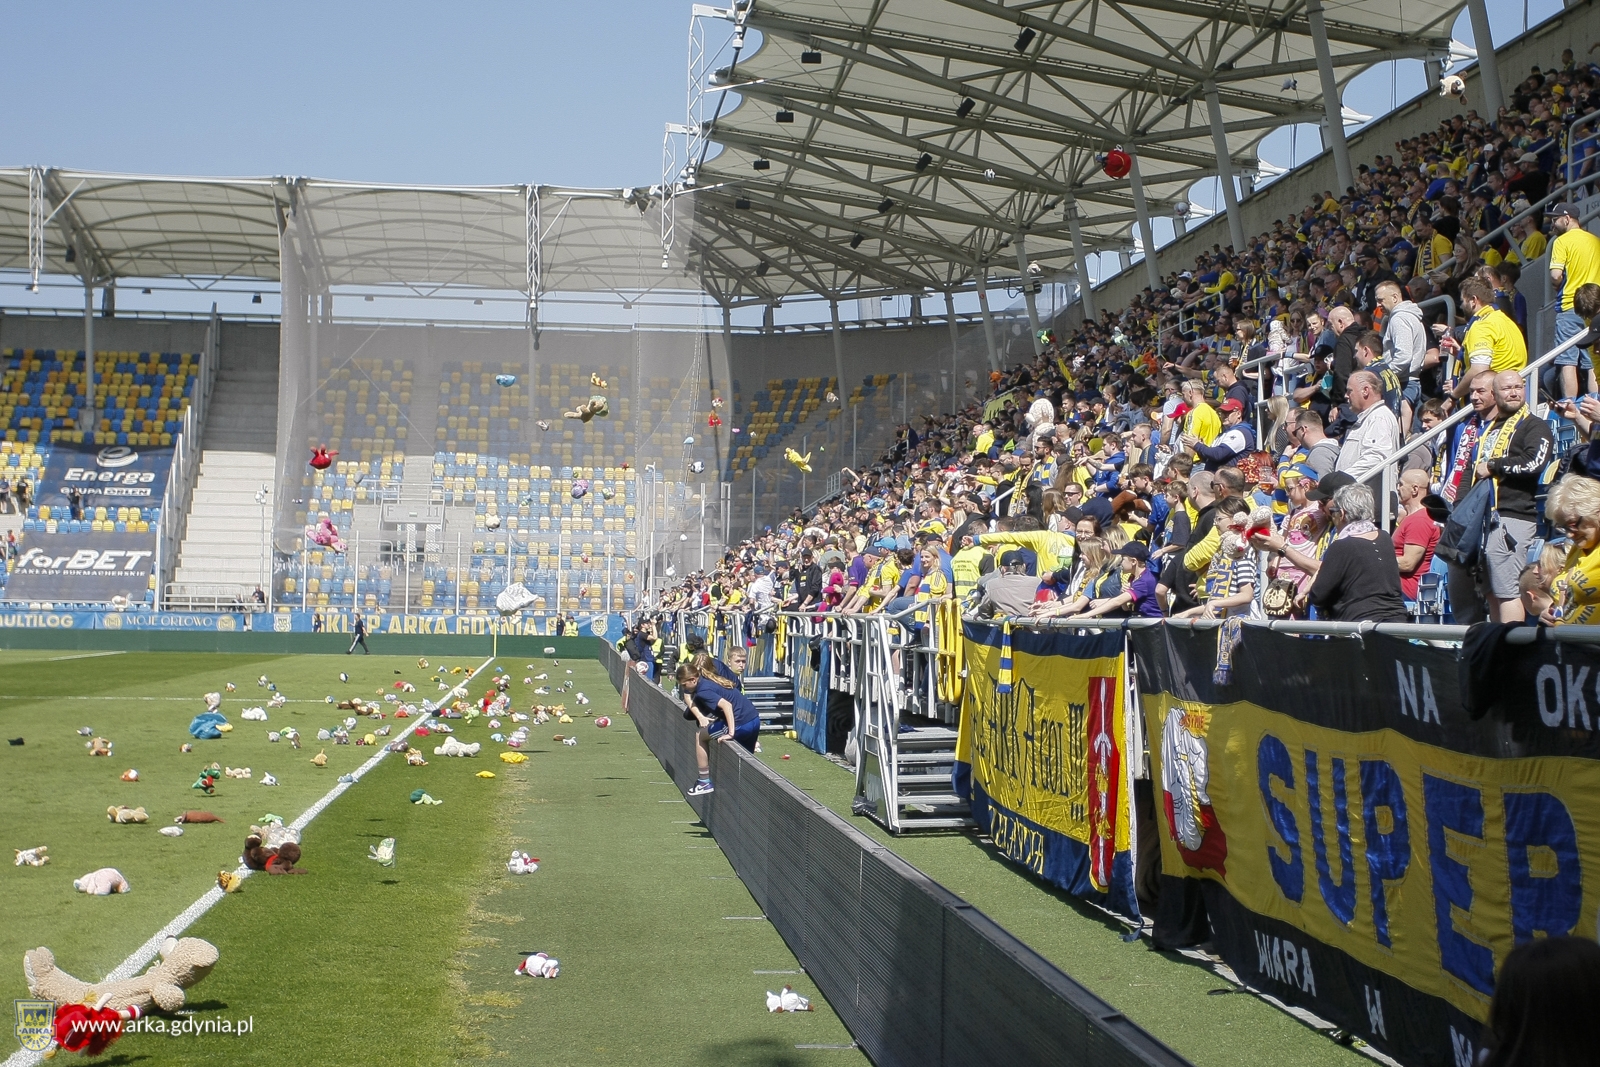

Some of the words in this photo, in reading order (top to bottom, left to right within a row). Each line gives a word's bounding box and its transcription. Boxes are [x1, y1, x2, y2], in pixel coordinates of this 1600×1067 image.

[64, 468, 155, 485] Energa
[60, 487, 102, 495] GUPA
[18, 548, 152, 569] forBET
[1571, 570, 1597, 597] SIŁA
[126, 615, 157, 626] MOJE
[1395, 660, 1441, 725] NA
[1536, 664, 1600, 731] OK
[1256, 734, 1583, 996] SUPER
[1254, 929, 1317, 998] WIARA
